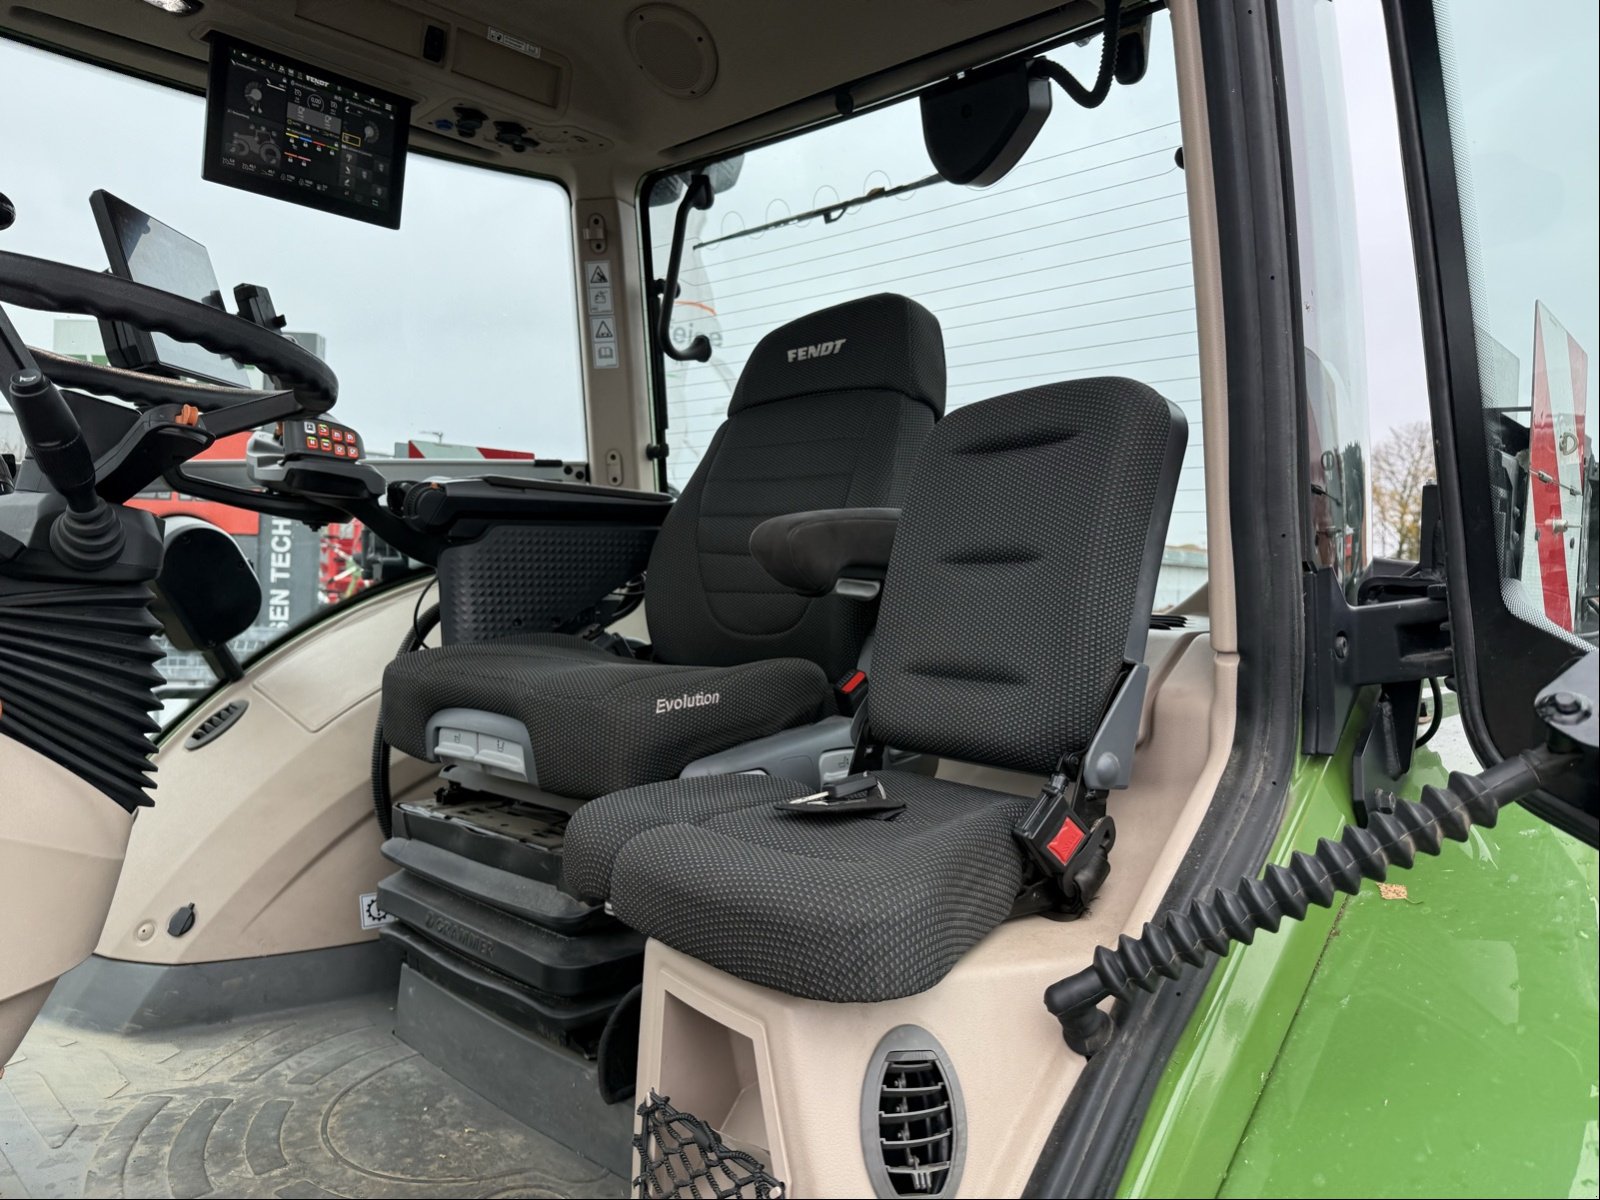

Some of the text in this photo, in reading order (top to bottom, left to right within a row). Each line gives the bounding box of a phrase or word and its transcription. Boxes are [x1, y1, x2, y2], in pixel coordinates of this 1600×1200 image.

[305, 74, 330, 88] FENDT
[787, 338, 847, 363] FENDT
[269, 516, 292, 584] TECH
[655, 691, 720, 714] Evolution
